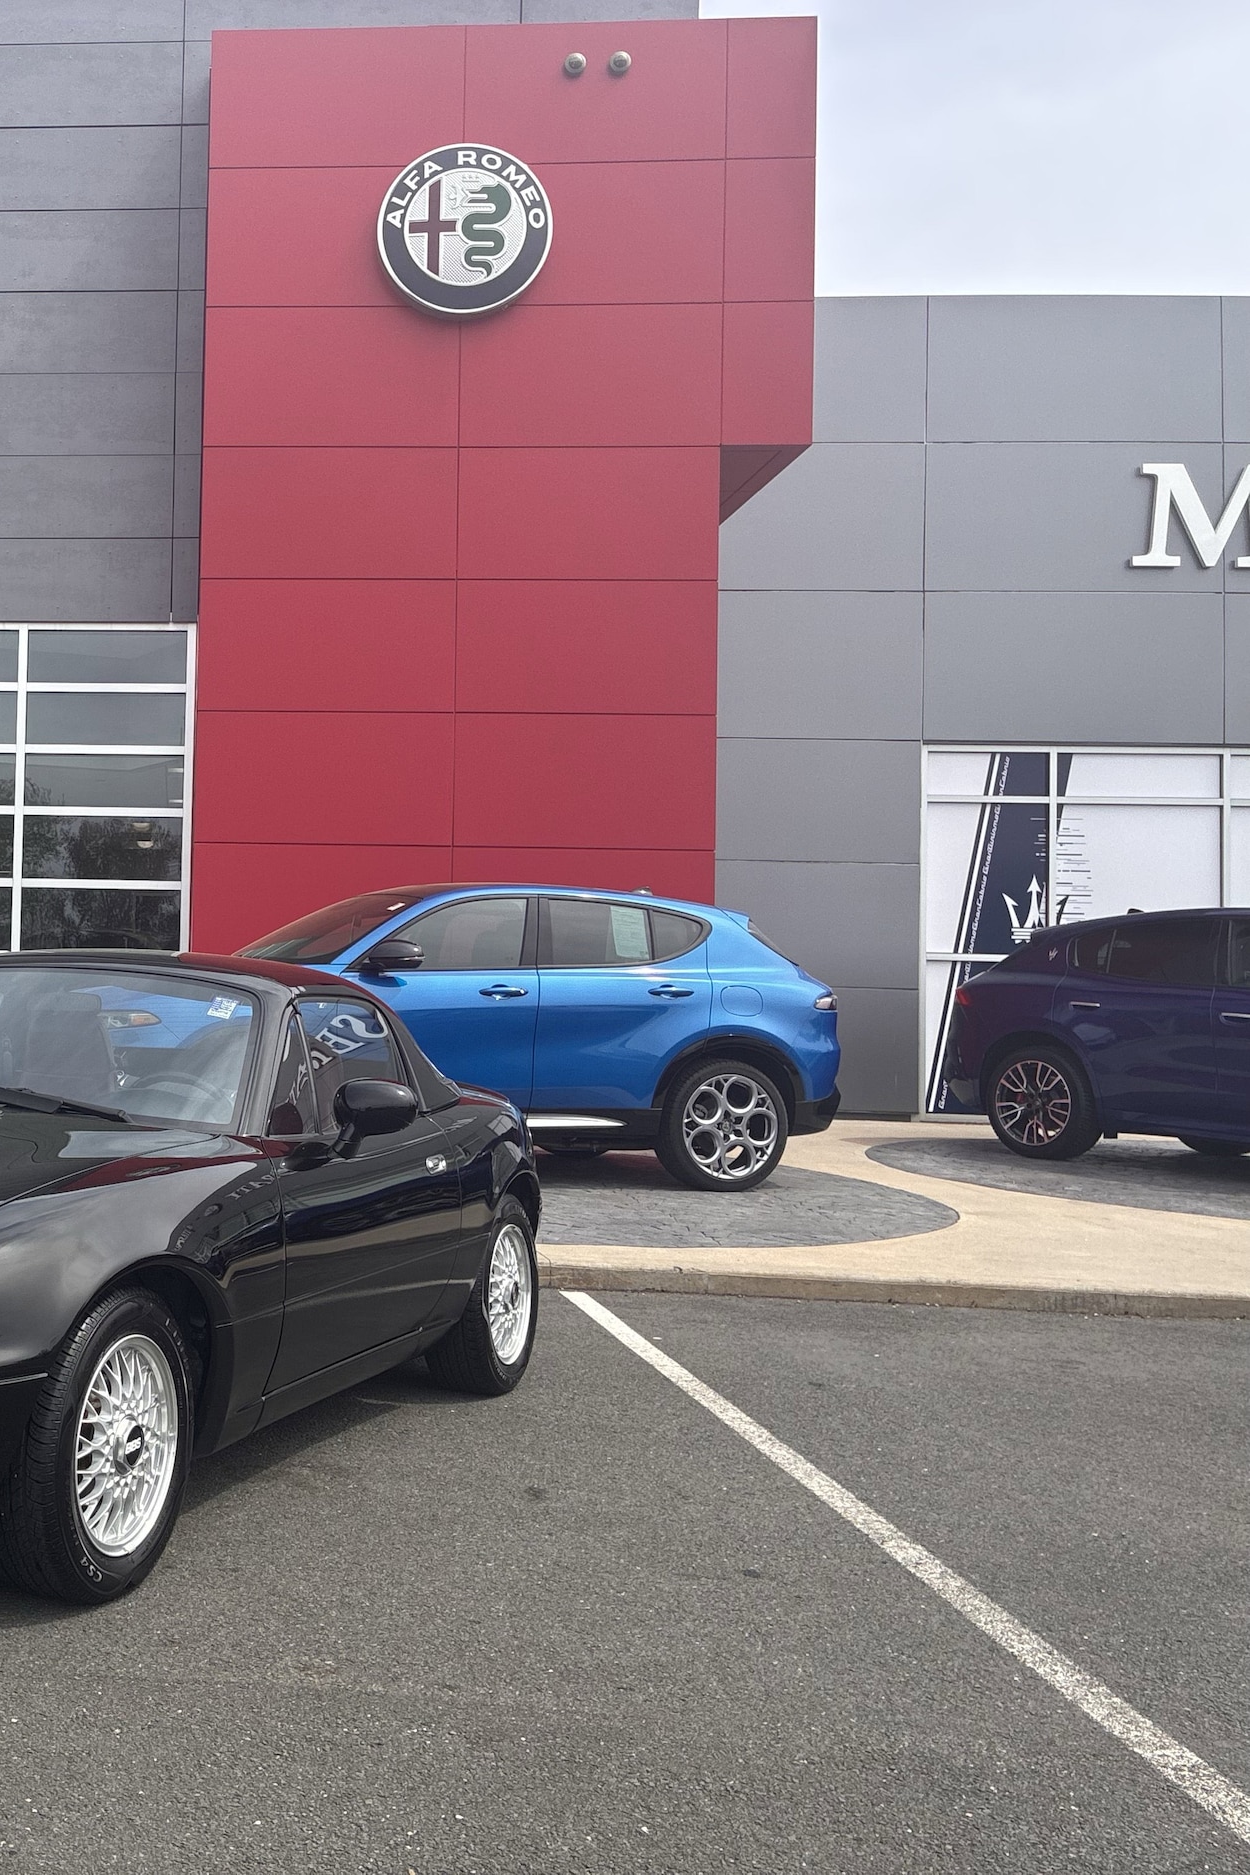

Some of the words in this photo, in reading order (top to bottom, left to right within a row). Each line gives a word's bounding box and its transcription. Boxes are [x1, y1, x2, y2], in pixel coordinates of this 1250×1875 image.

[386, 161, 443, 229] ALFA
[457, 150, 546, 229] ROMEO
[1130, 463, 1250, 569] M
[80, 1556, 102, 1583] CS4
